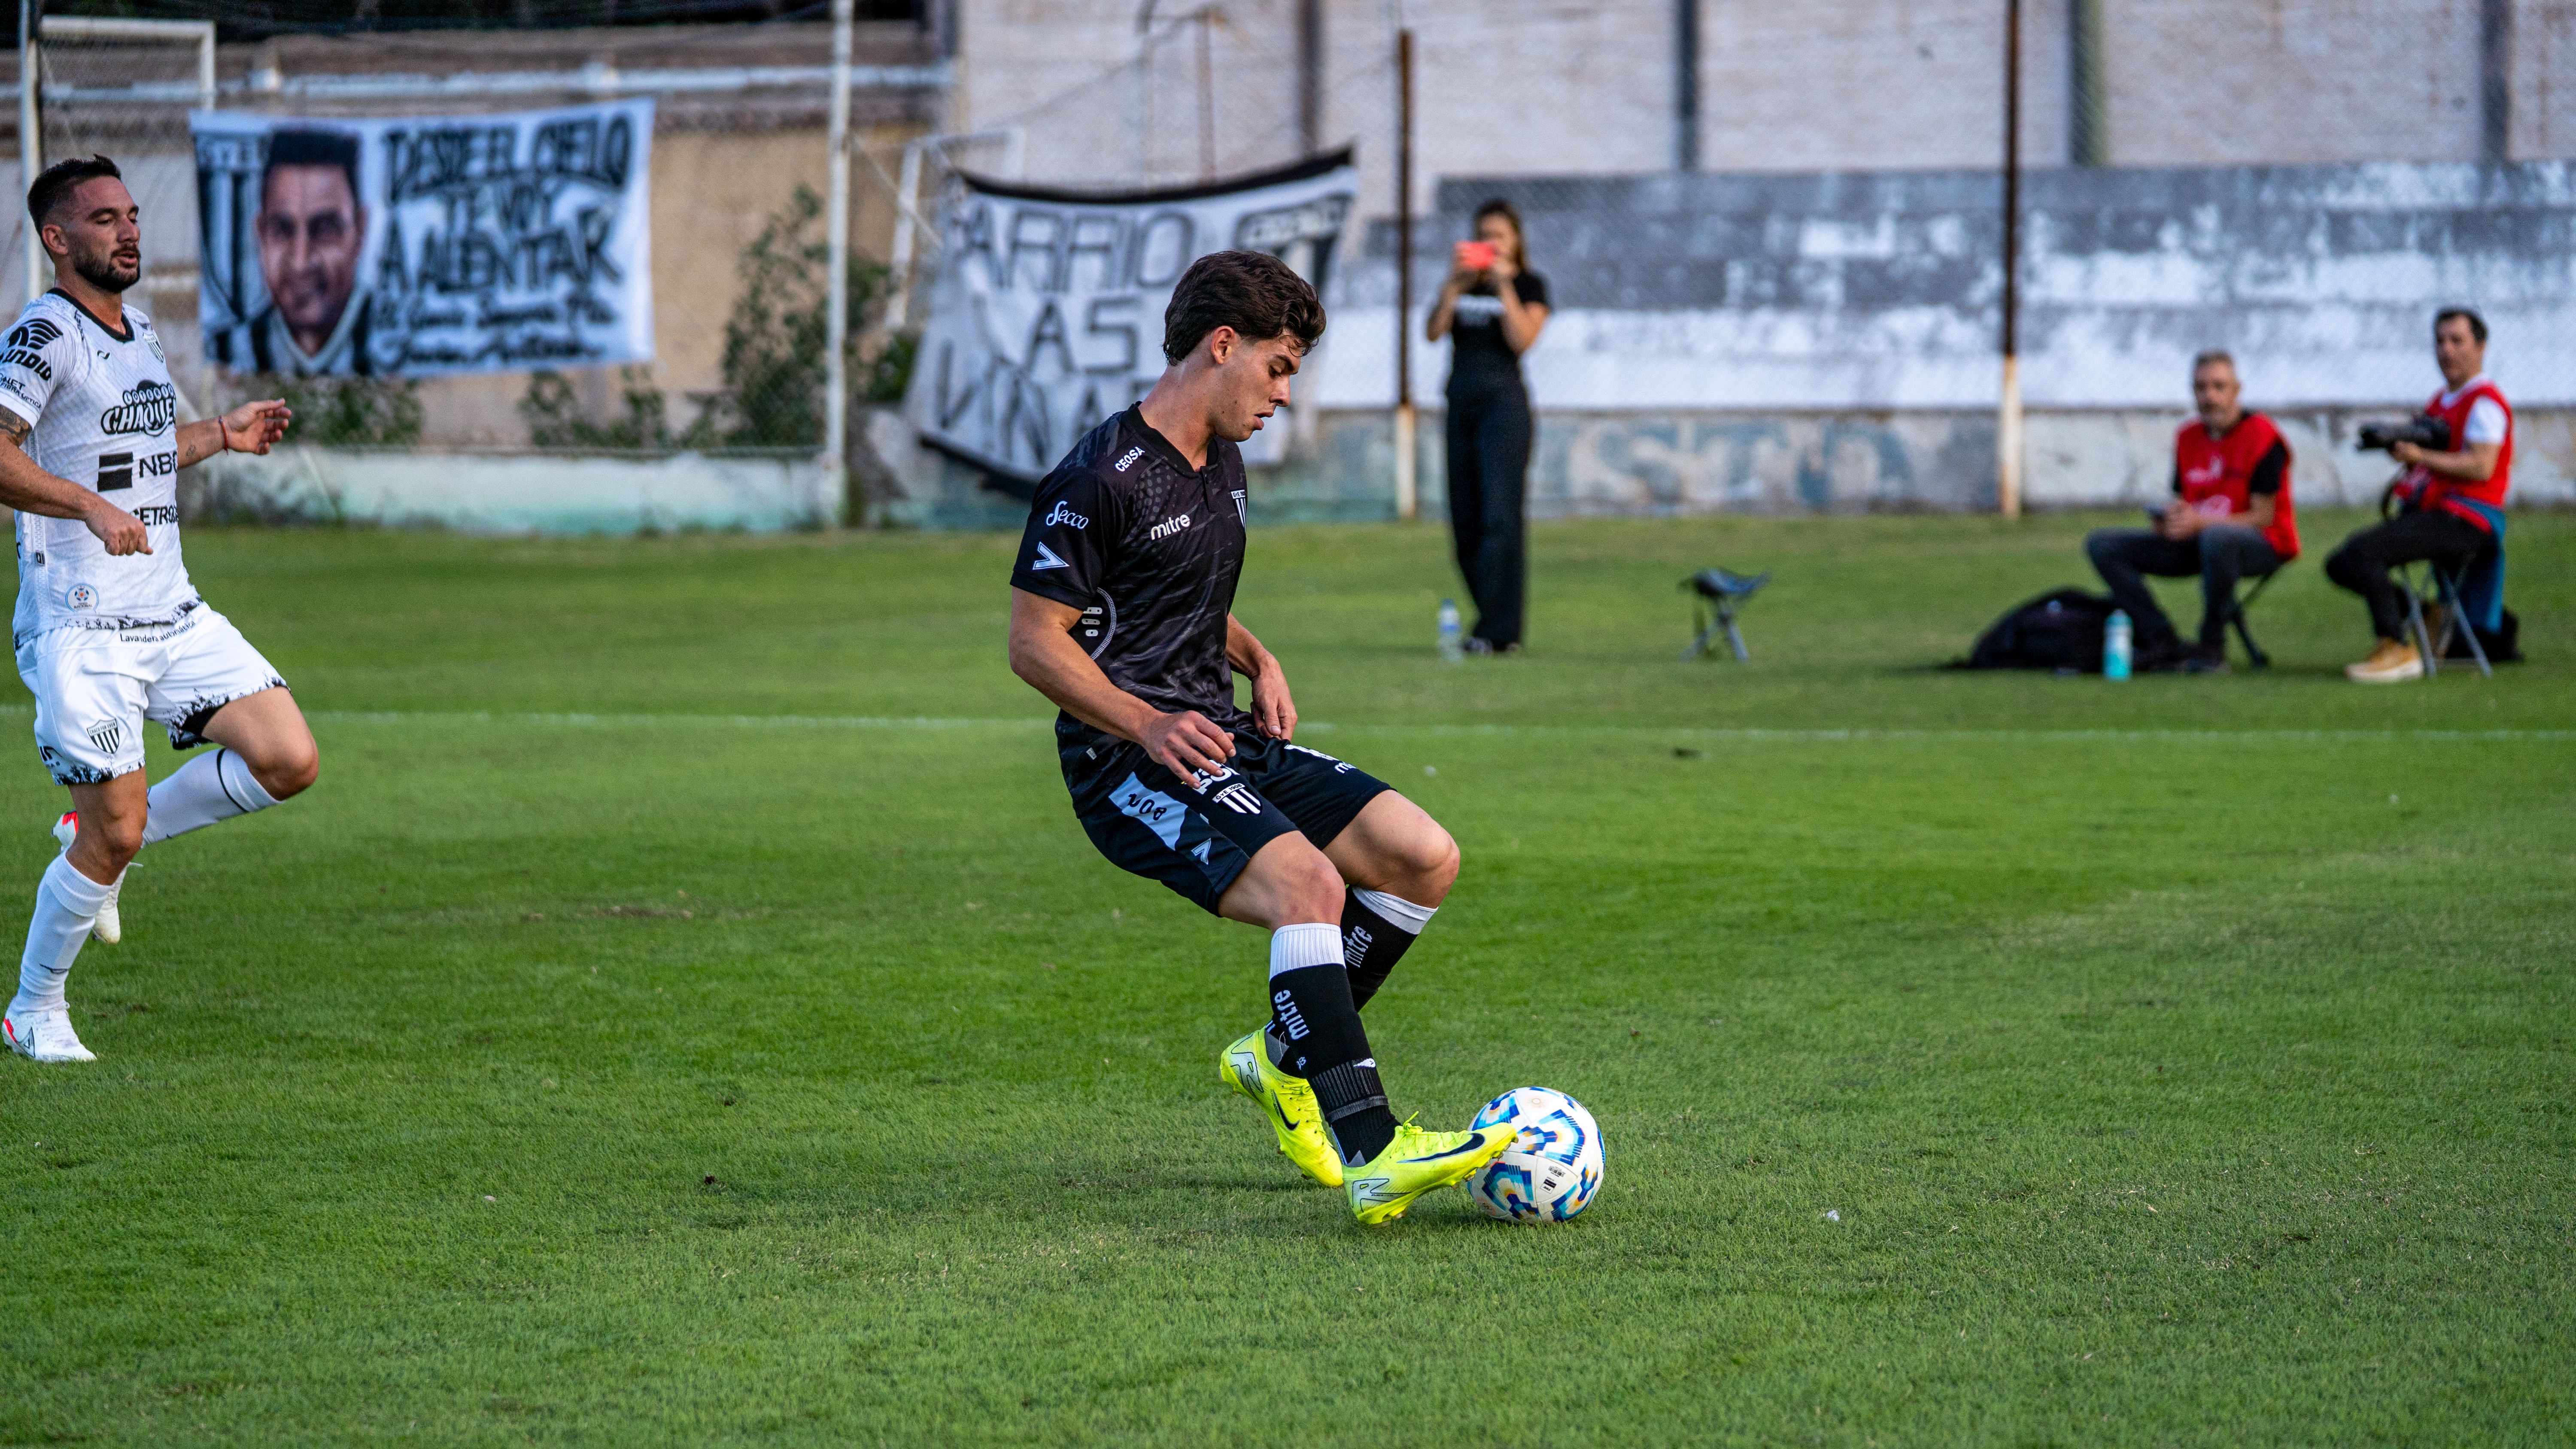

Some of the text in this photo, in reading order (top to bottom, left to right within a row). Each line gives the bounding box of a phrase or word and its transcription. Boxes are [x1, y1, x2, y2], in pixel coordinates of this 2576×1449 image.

[378, 210, 623, 298] A ALENTAR
[124, 384, 174, 404] LOTERIA
[1115, 446, 1145, 472] CEOSA
[1046, 500, 1088, 530] Secco
[1151, 514, 1191, 540] mitre
[1343, 925, 1373, 968] mitre
[1274, 989, 1310, 1040] mitre
